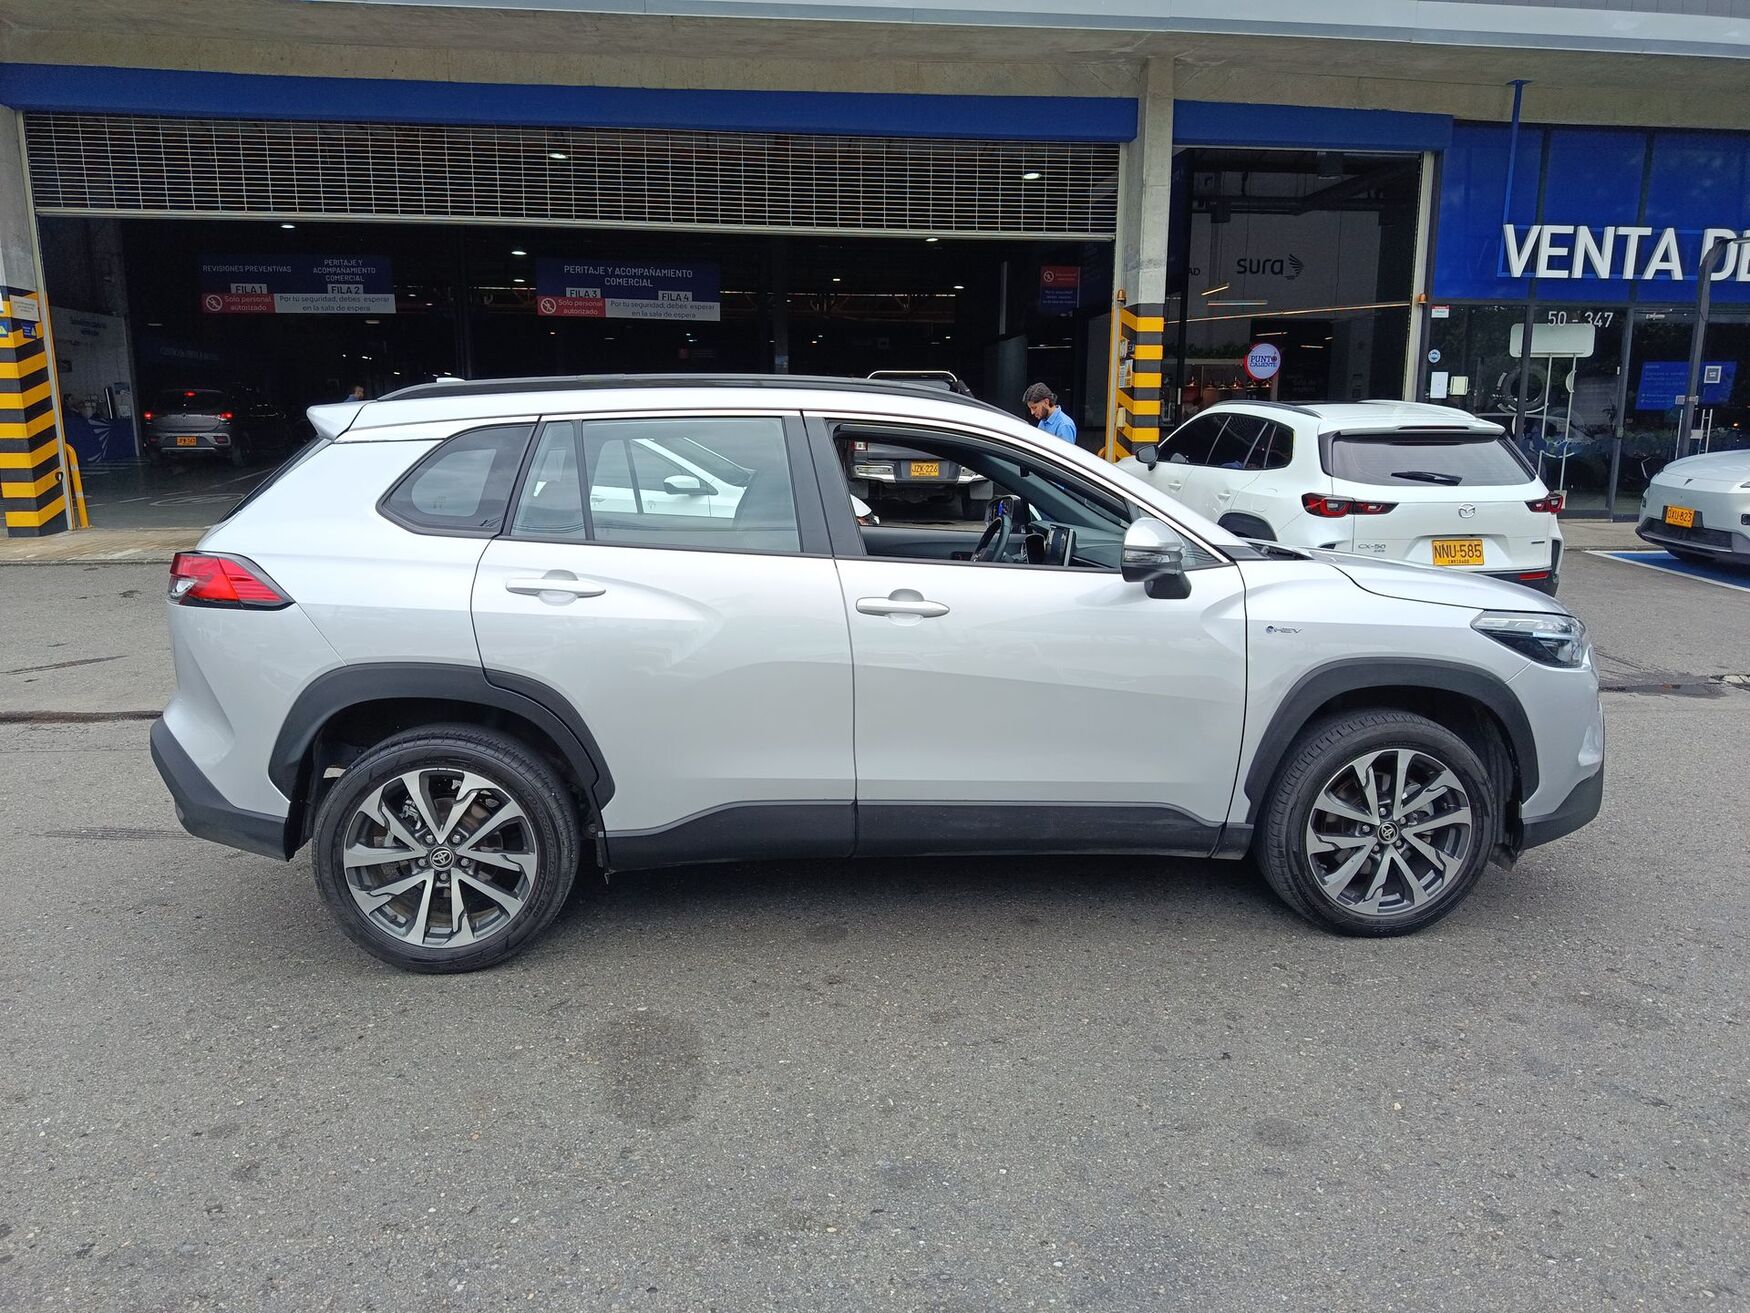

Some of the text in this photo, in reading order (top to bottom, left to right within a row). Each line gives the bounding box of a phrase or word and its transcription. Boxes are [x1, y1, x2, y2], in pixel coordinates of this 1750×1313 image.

[1503, 224, 1683, 280] VENTA
[245, 265, 292, 273] PREVENTIVAS
[1237, 258, 1283, 275] sura
[564, 265, 693, 278] PERITAJE Y ACOMPAÑAMIENTO
[326, 274, 364, 282] COMERCIAL
[604, 277, 653, 287] COMERCIAL
[235, 285, 257, 294] FILA
[331, 285, 360, 294] FILA 2
[570, 289, 590, 298] FILA
[661, 292, 681, 301] FILA
[574, 299, 603, 307] personal
[1547, 311, 1567, 326] 50
[1584, 311, 1614, 328] 347
[1434, 544, 1482, 558] NNU-585
